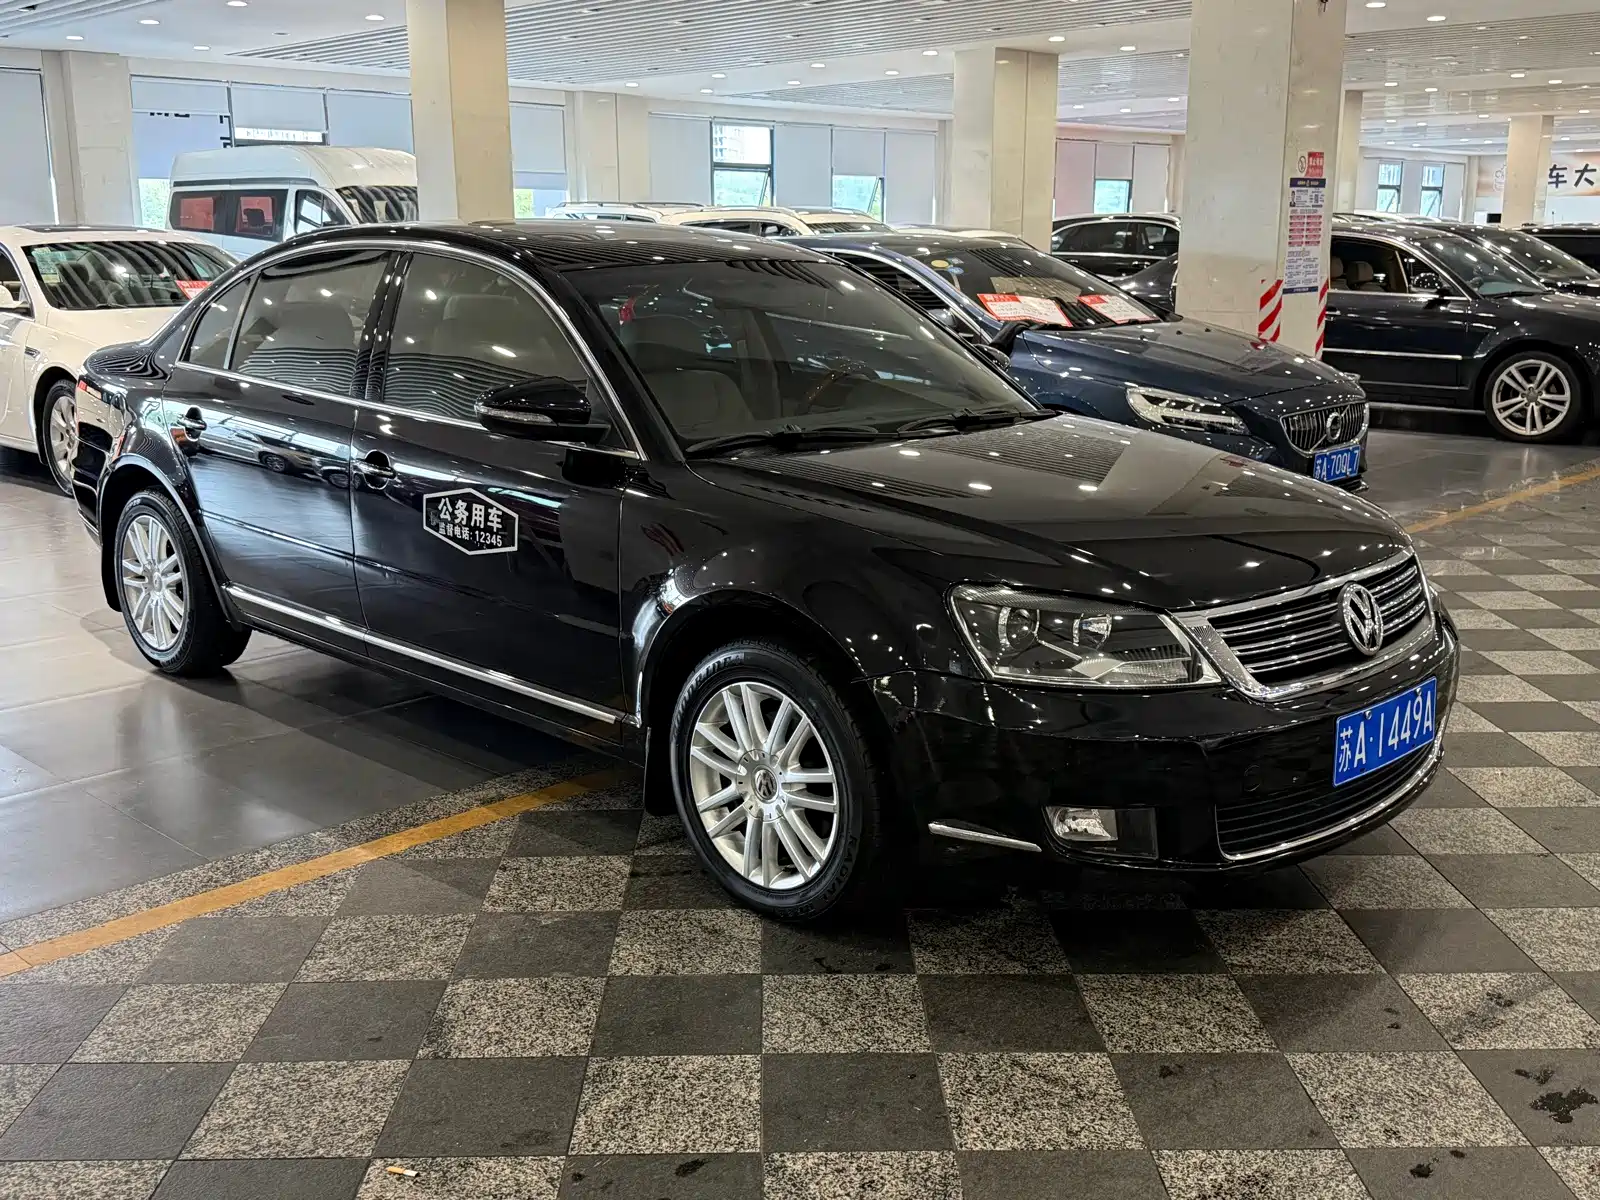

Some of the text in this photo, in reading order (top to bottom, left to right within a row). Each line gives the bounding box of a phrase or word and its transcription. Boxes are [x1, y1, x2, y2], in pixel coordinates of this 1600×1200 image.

[437, 497, 503, 533] 公务用车
[1338, 690, 1433, 773] 苏A·1449A
